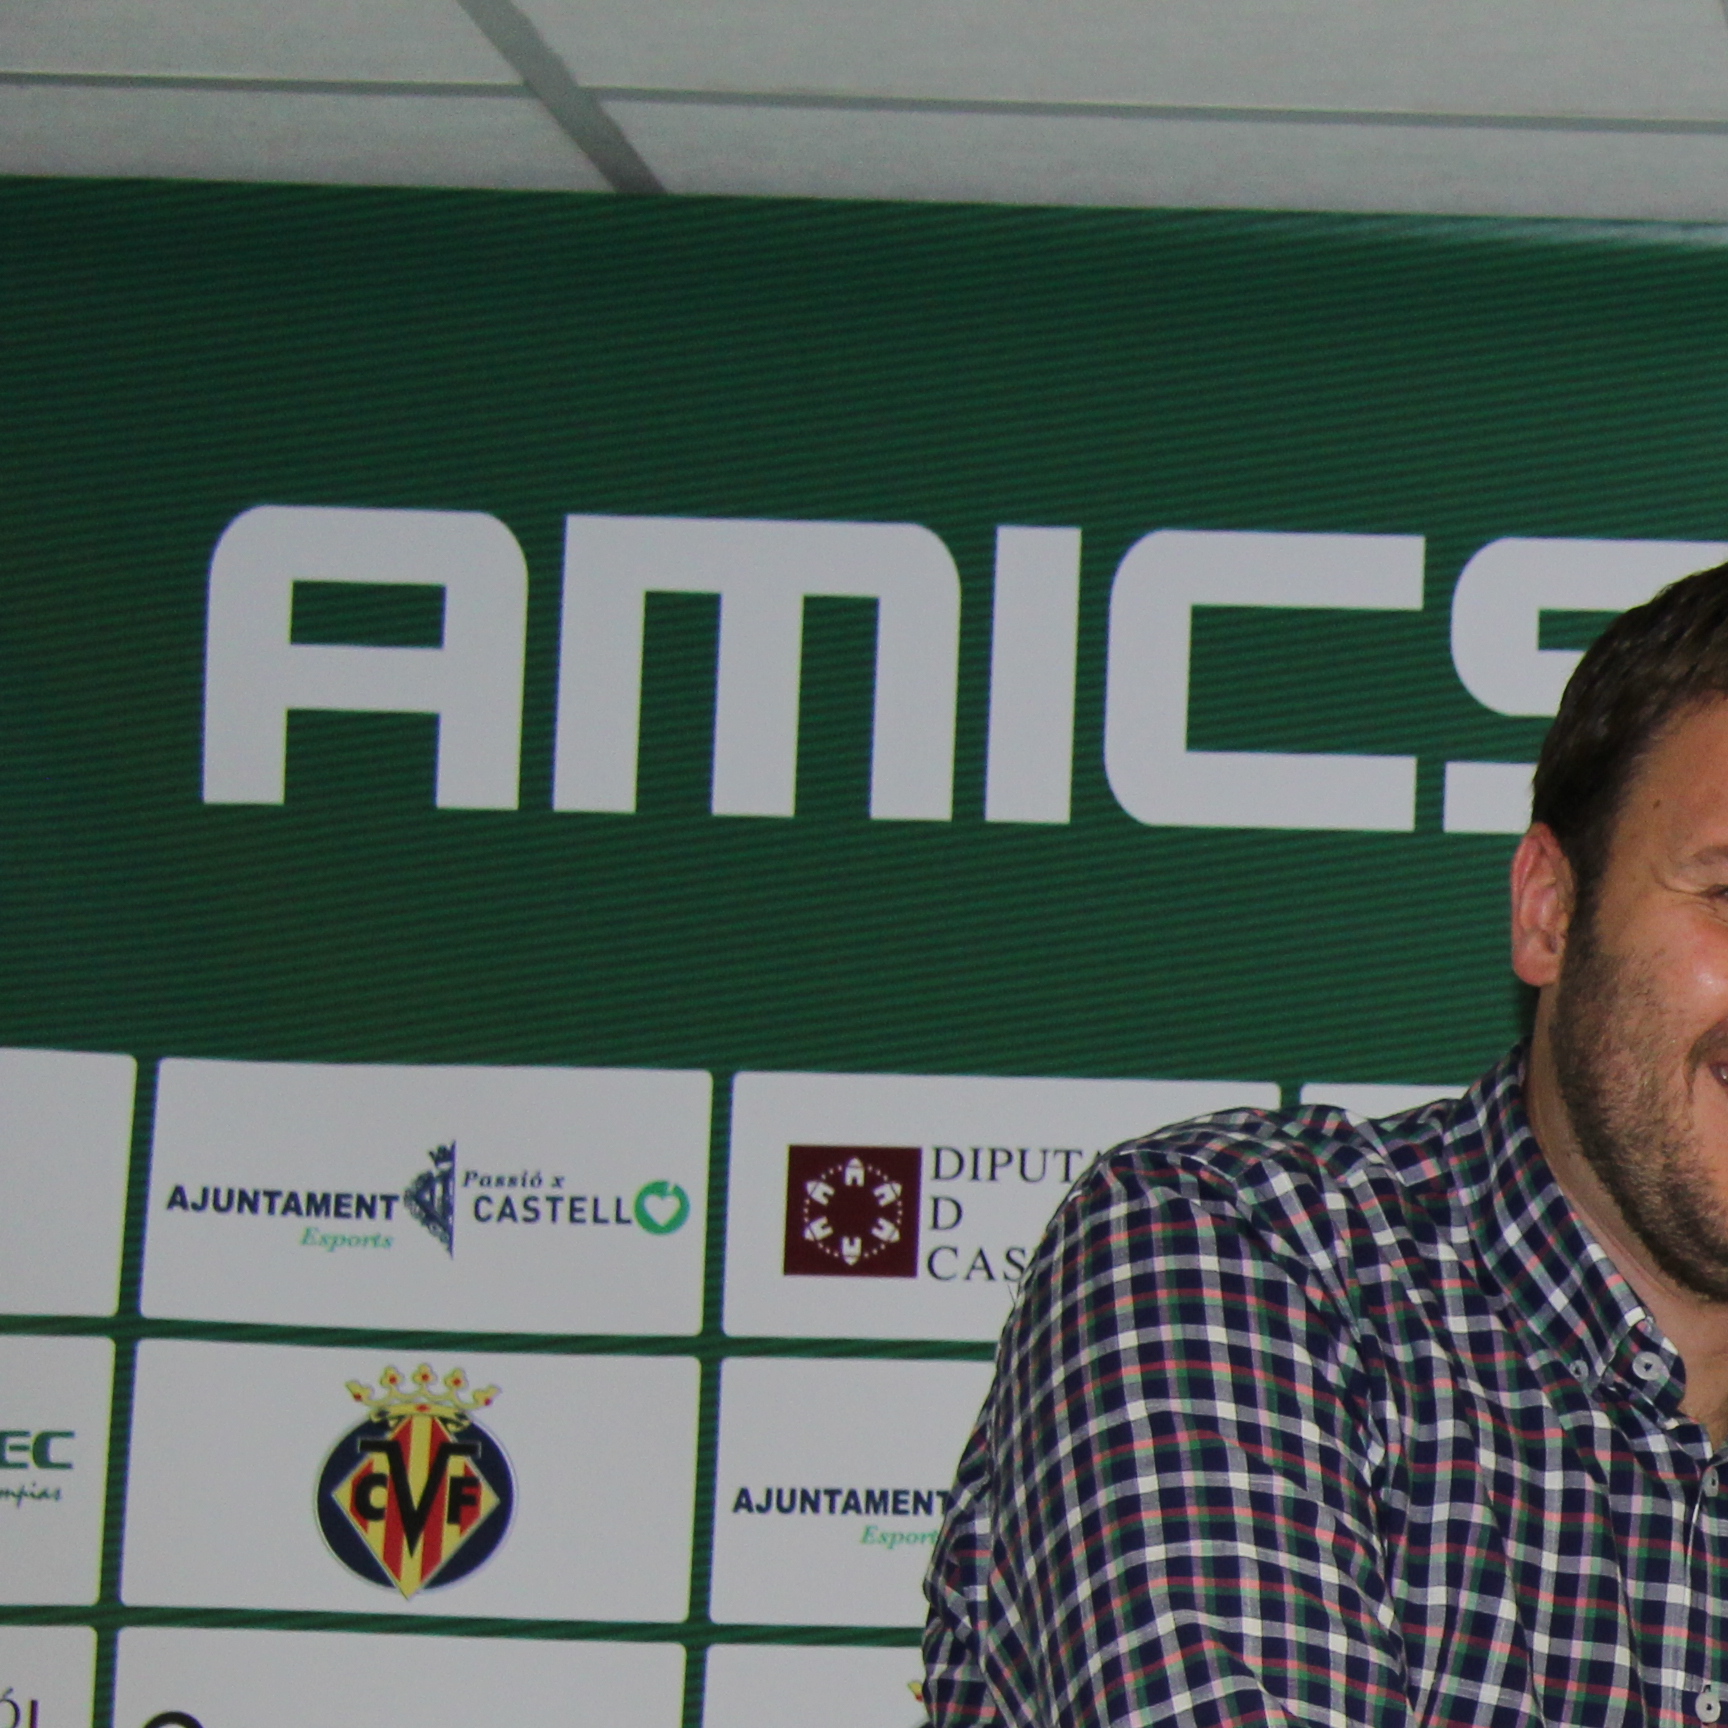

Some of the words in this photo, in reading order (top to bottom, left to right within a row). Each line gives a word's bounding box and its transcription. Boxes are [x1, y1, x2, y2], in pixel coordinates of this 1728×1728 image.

[930, 1144, 1084, 1184] DIPUT
[462, 1170, 543, 1188] Passió
[167, 1185, 400, 1220] AJUNTAMENT
[300, 1227, 393, 1252] Esports
[860, 1524, 939, 1549] Esport
